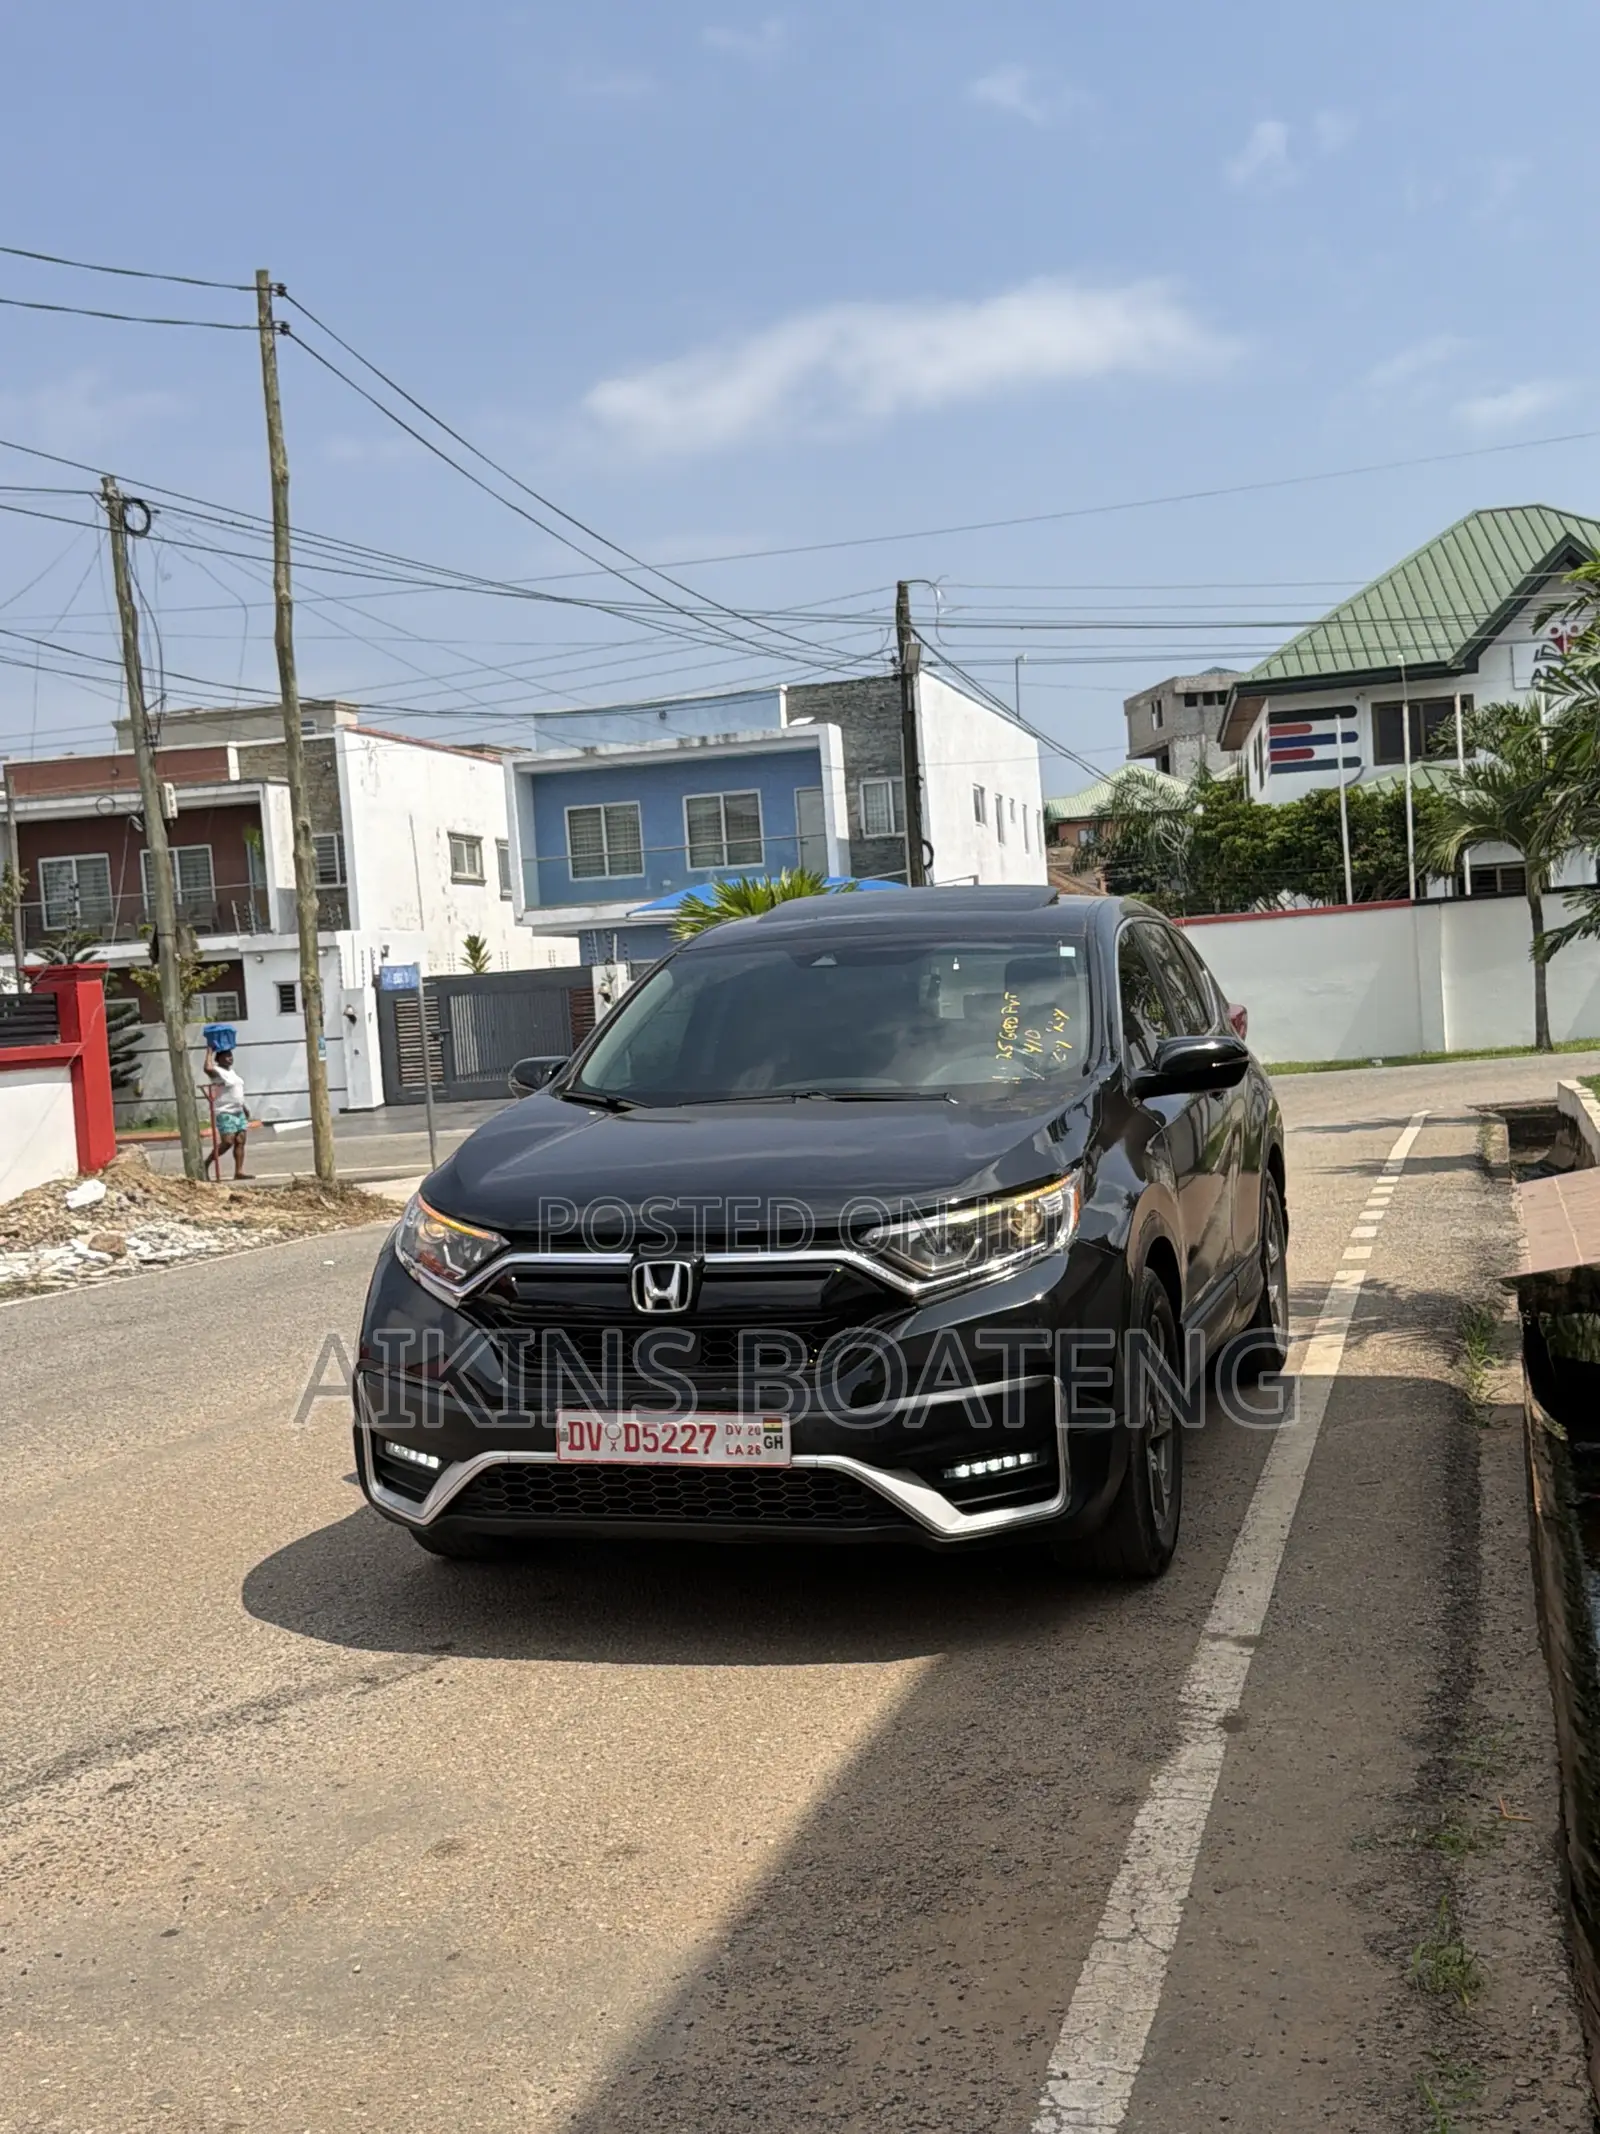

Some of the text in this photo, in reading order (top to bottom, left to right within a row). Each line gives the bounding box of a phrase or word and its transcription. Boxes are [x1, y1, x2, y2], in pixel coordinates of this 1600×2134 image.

[725, 1424, 742, 1436] DV
[568, 1421, 717, 1454] DV D5227
[763, 1435, 783, 1450] GH
[725, 1443, 744, 1456] LA
